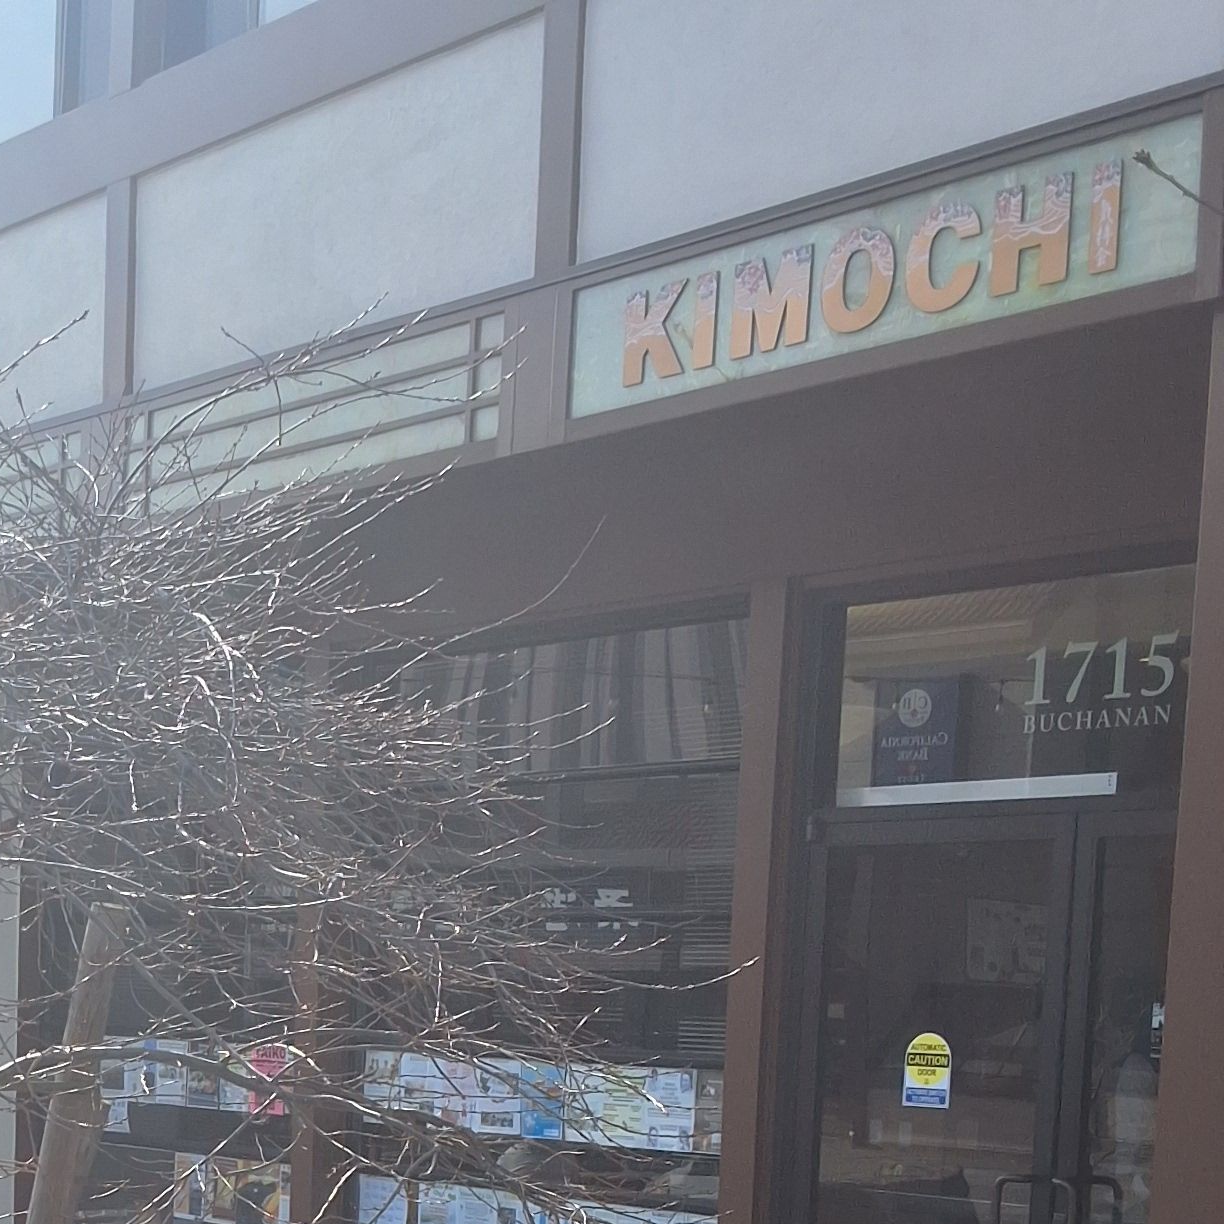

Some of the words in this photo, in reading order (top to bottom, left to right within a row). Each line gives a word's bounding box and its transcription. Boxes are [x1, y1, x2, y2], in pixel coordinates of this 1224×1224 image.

[622, 158, 1124, 389] KIMOCHI
[1025, 629, 1180, 706] 1715
[1024, 705, 1172, 734] BUCHANAN
[908, 1055, 948, 1066] CAUTION
[917, 1069, 937, 1077] DOOR
